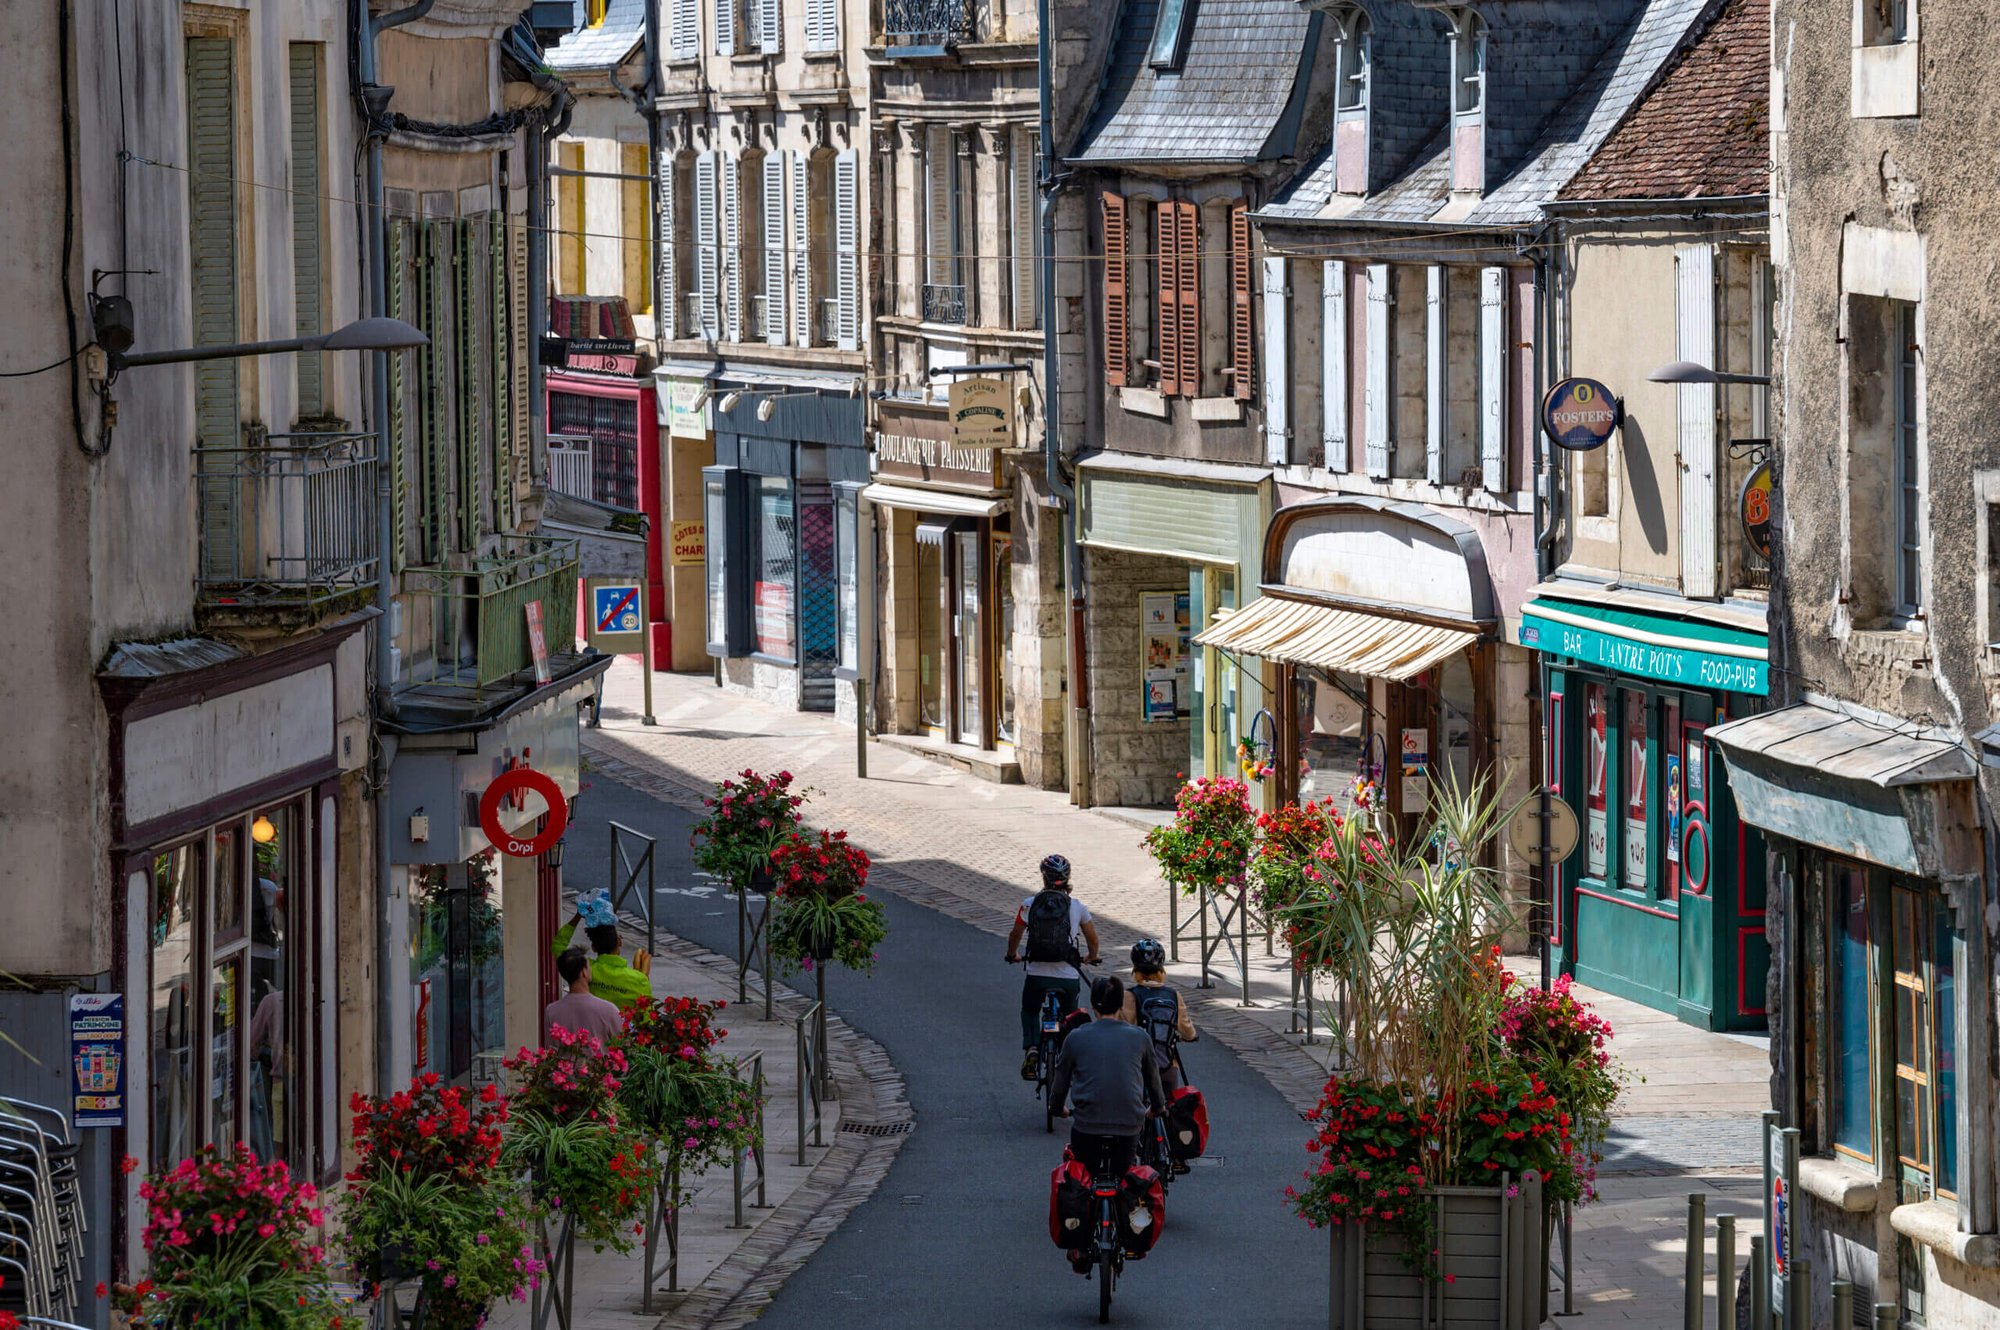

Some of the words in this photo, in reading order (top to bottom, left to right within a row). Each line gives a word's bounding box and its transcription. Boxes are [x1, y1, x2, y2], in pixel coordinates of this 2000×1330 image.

[963, 382, 996, 395] Artisan
[1552, 409, 1614, 425] FOSTER'S
[880, 434, 936, 467] BOULANGERIE
[625, 617, 635, 625] 20
[1563, 631, 1582, 655] BAR
[1599, 638, 1645, 671] L'ANTRE
[1648, 650, 1682, 677] POT'S
[1700, 659, 1757, 689] FOOD-PUB
[508, 841, 534, 855] Orpi
